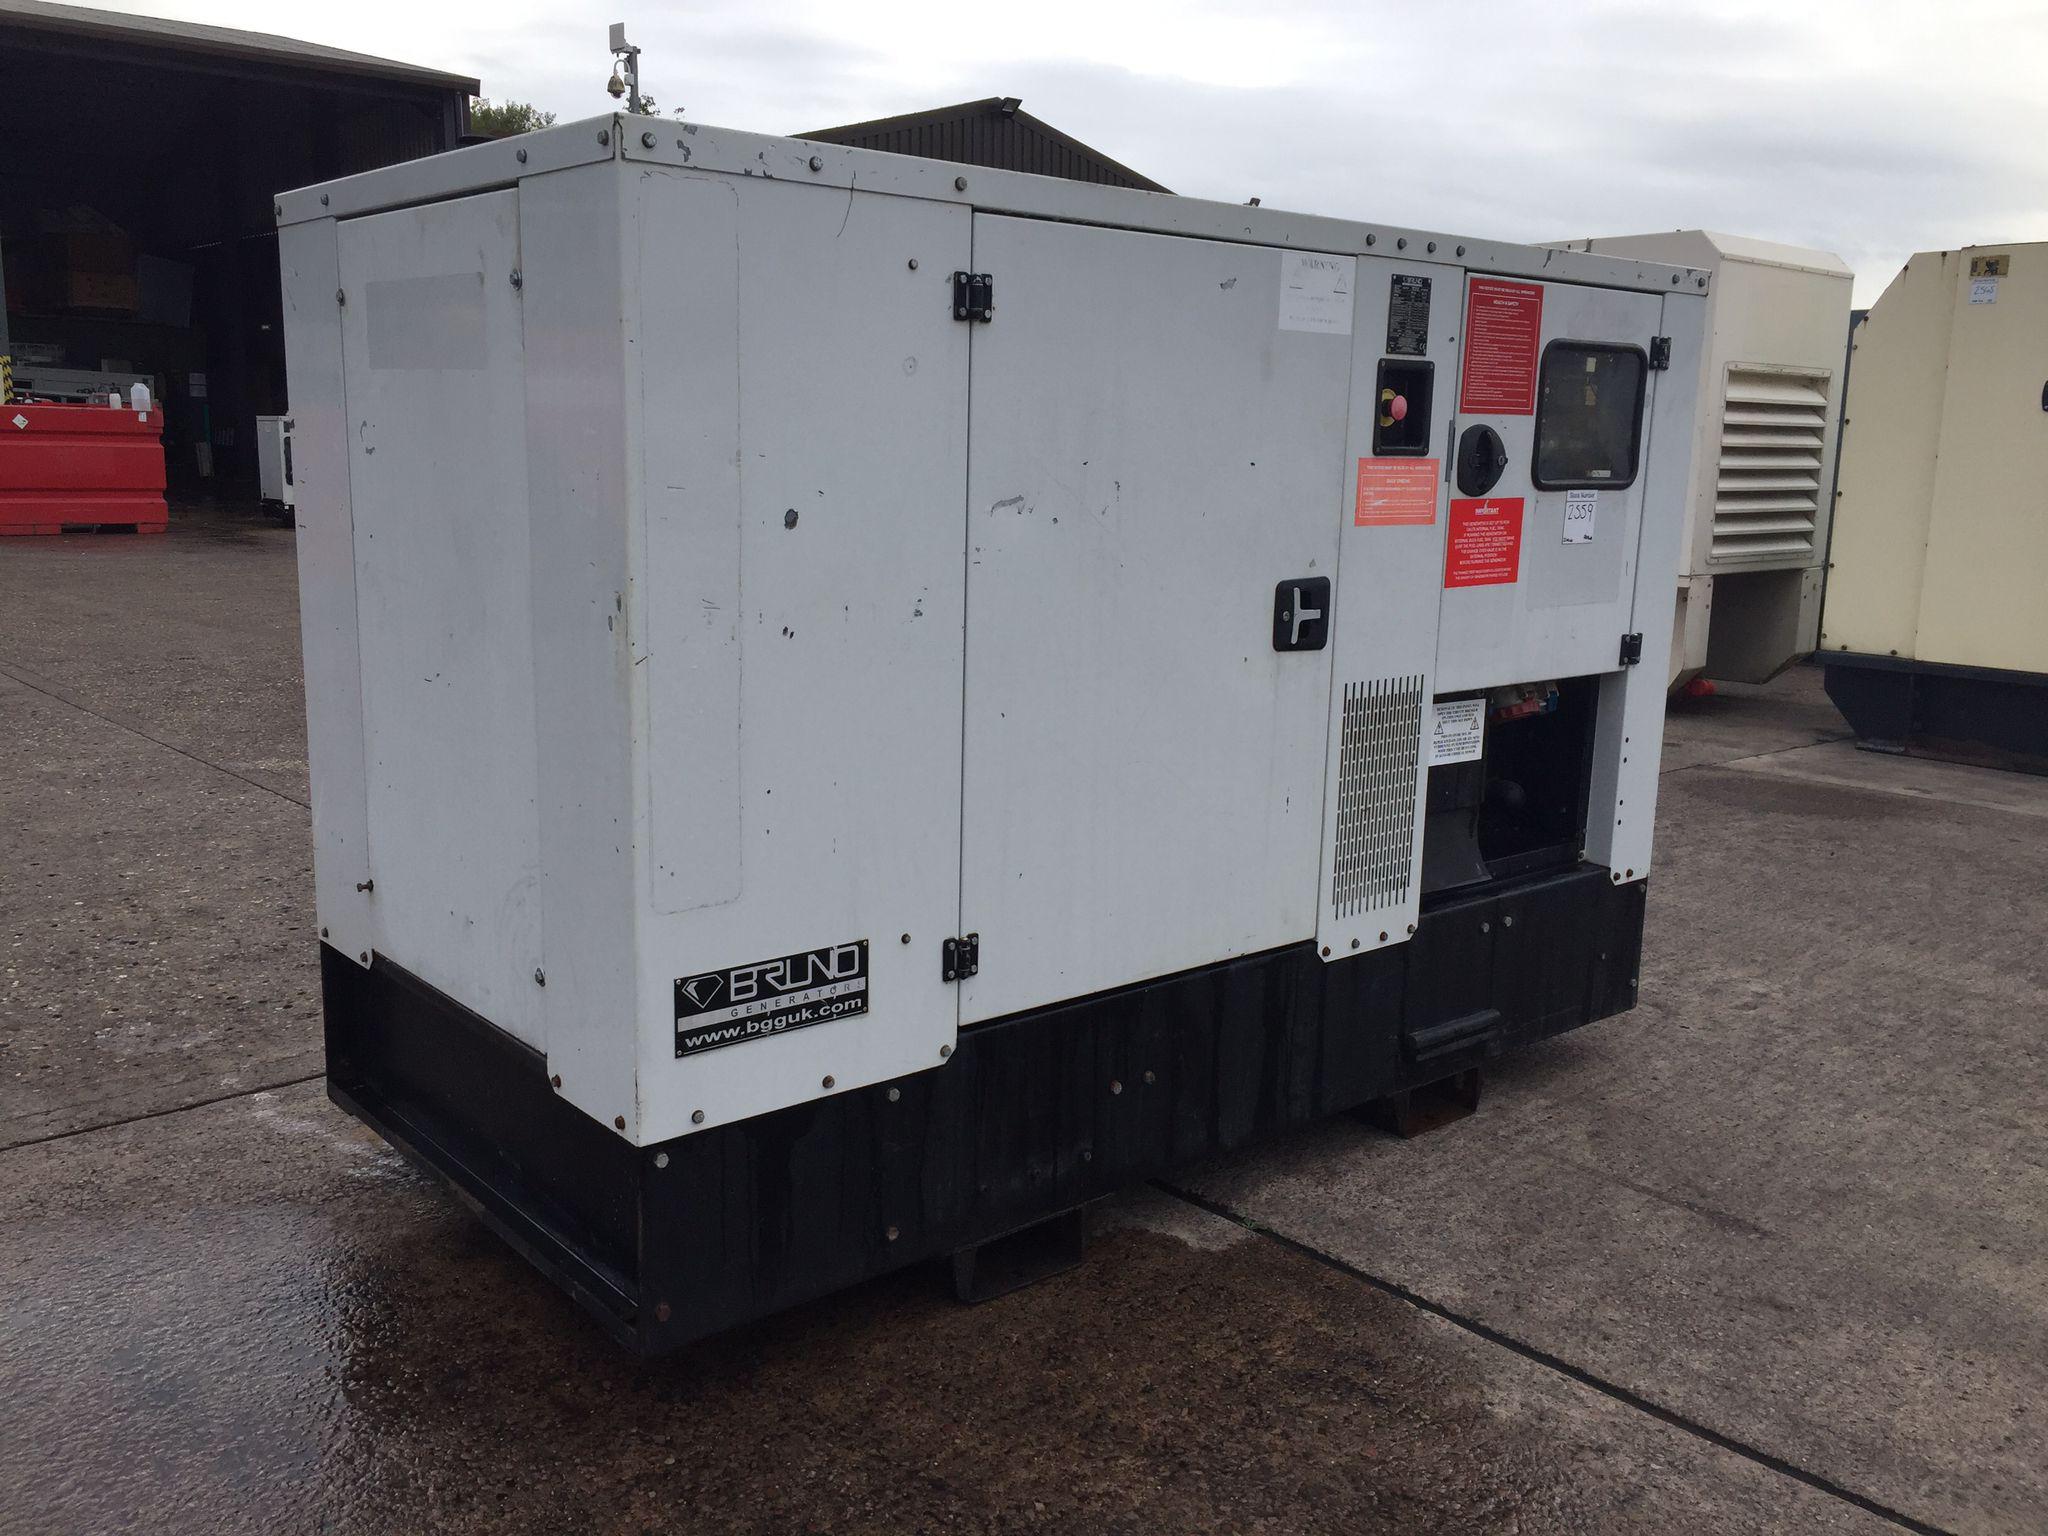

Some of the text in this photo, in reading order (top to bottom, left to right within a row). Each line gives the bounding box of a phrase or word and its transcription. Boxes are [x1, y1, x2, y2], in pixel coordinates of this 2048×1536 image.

[1568, 503, 1594, 522] 2559
[730, 944, 860, 1002] BRUNO
[685, 997, 862, 1048] www.bgguk.com
